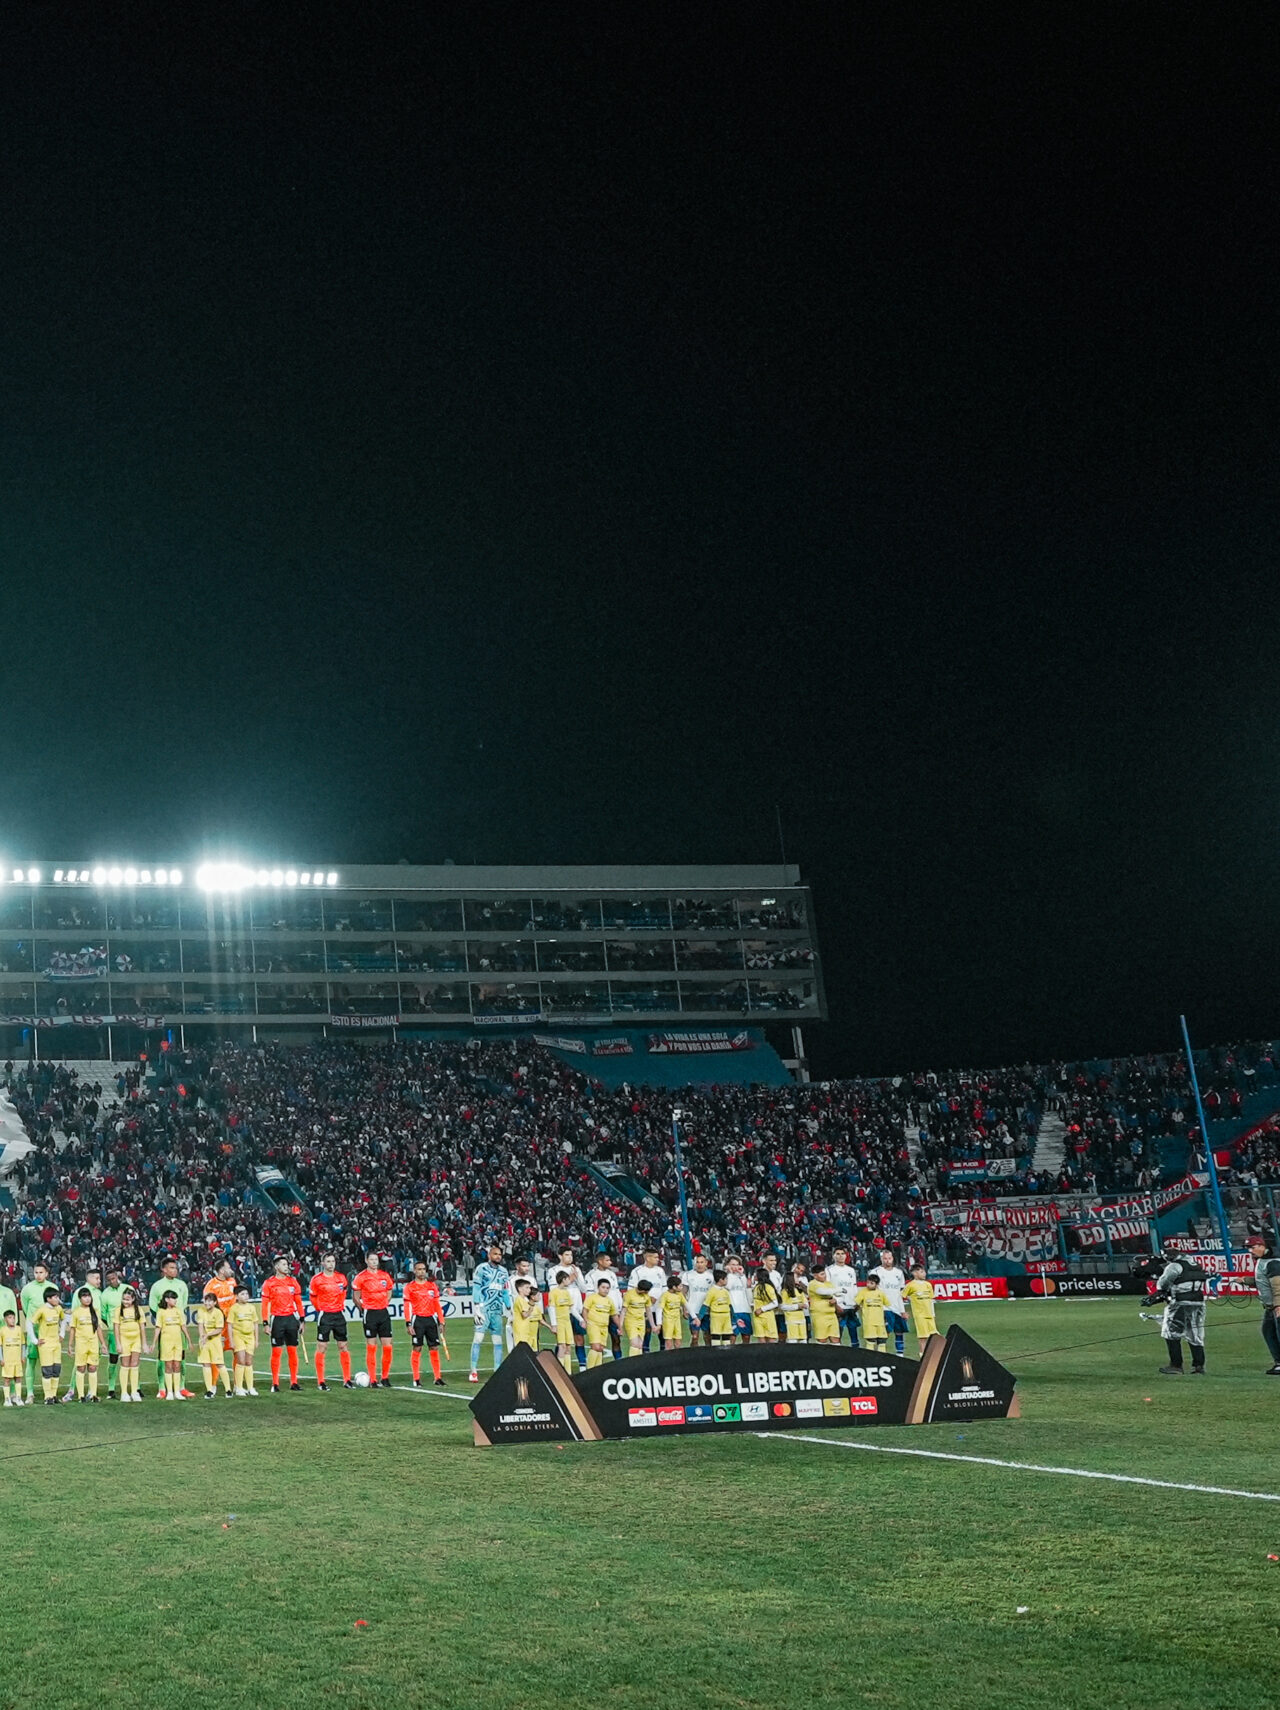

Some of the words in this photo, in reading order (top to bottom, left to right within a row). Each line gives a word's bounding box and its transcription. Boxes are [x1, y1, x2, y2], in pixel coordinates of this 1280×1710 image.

[331, 1015, 350, 1025] ESTO
[350, 1016, 361, 1026] ES
[361, 1015, 399, 1027] NACIONAL
[475, 1015, 506, 1023] NACIONAL
[933, 1282, 994, 1297] APFRE
[1058, 1277, 1122, 1293] priceless
[602, 1373, 732, 1401] CONMEBOL
[735, 1366, 894, 1395] LIBERTADORES
[948, 1390, 995, 1401] LIBERTADORES
[852, 1401, 875, 1411] TCL
[499, 1413, 551, 1423] LIBERTADORES
